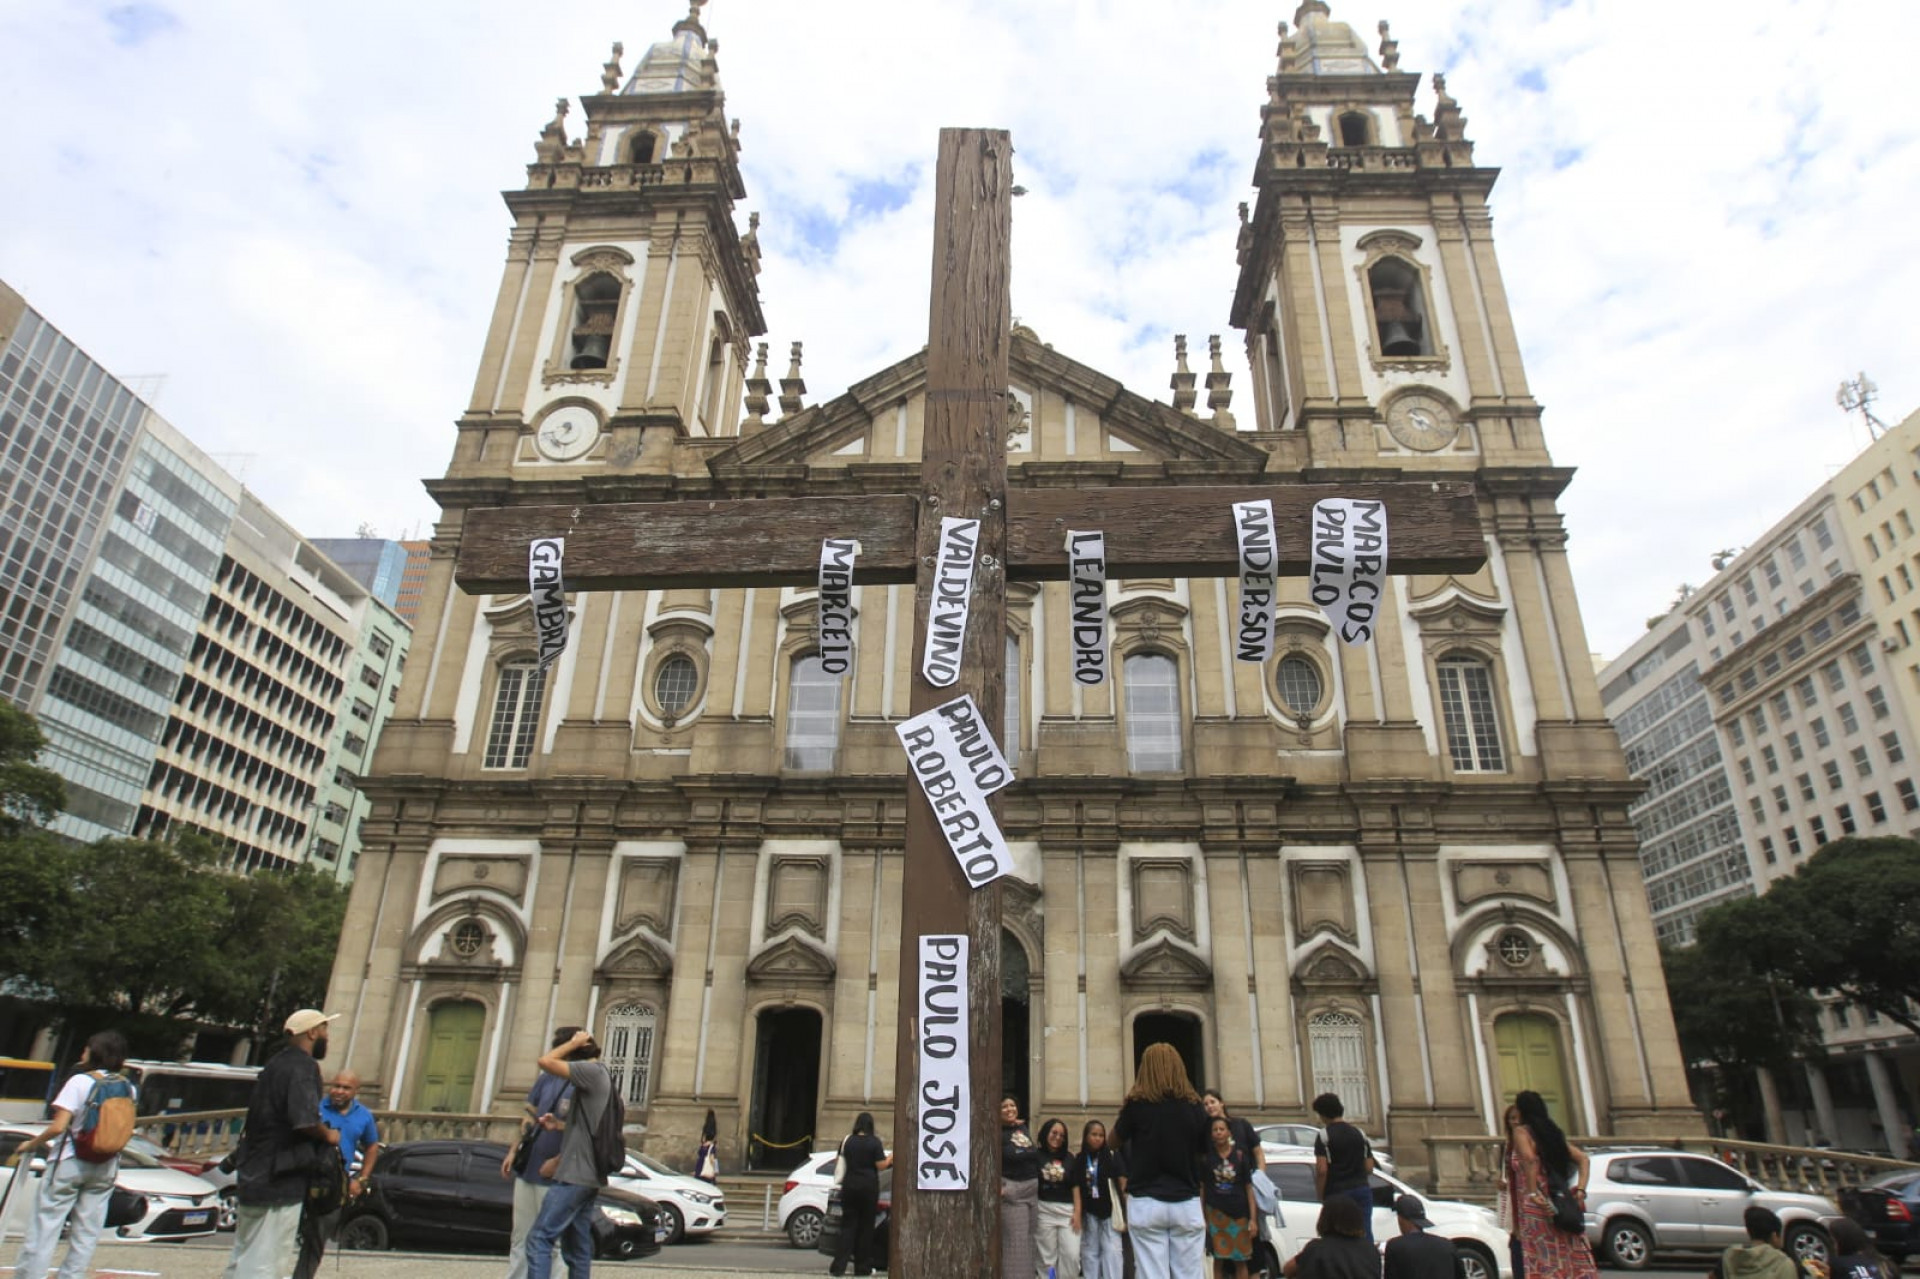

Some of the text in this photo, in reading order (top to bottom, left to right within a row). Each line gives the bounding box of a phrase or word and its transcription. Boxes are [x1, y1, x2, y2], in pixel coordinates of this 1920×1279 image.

[821, 540, 853, 674] MARCELO
[926, 520, 977, 685] VALDEVINO
[1071, 533, 1104, 685] LEANDRO
[1237, 504, 1273, 662] ANDERSON
[1312, 504, 1347, 606] PAULO
[1341, 501, 1382, 643] MARCOS
[903, 725, 999, 882] ROBERTO
[937, 699, 1005, 790] PAULO
[919, 938, 967, 1184] PAULO JOSÉ
